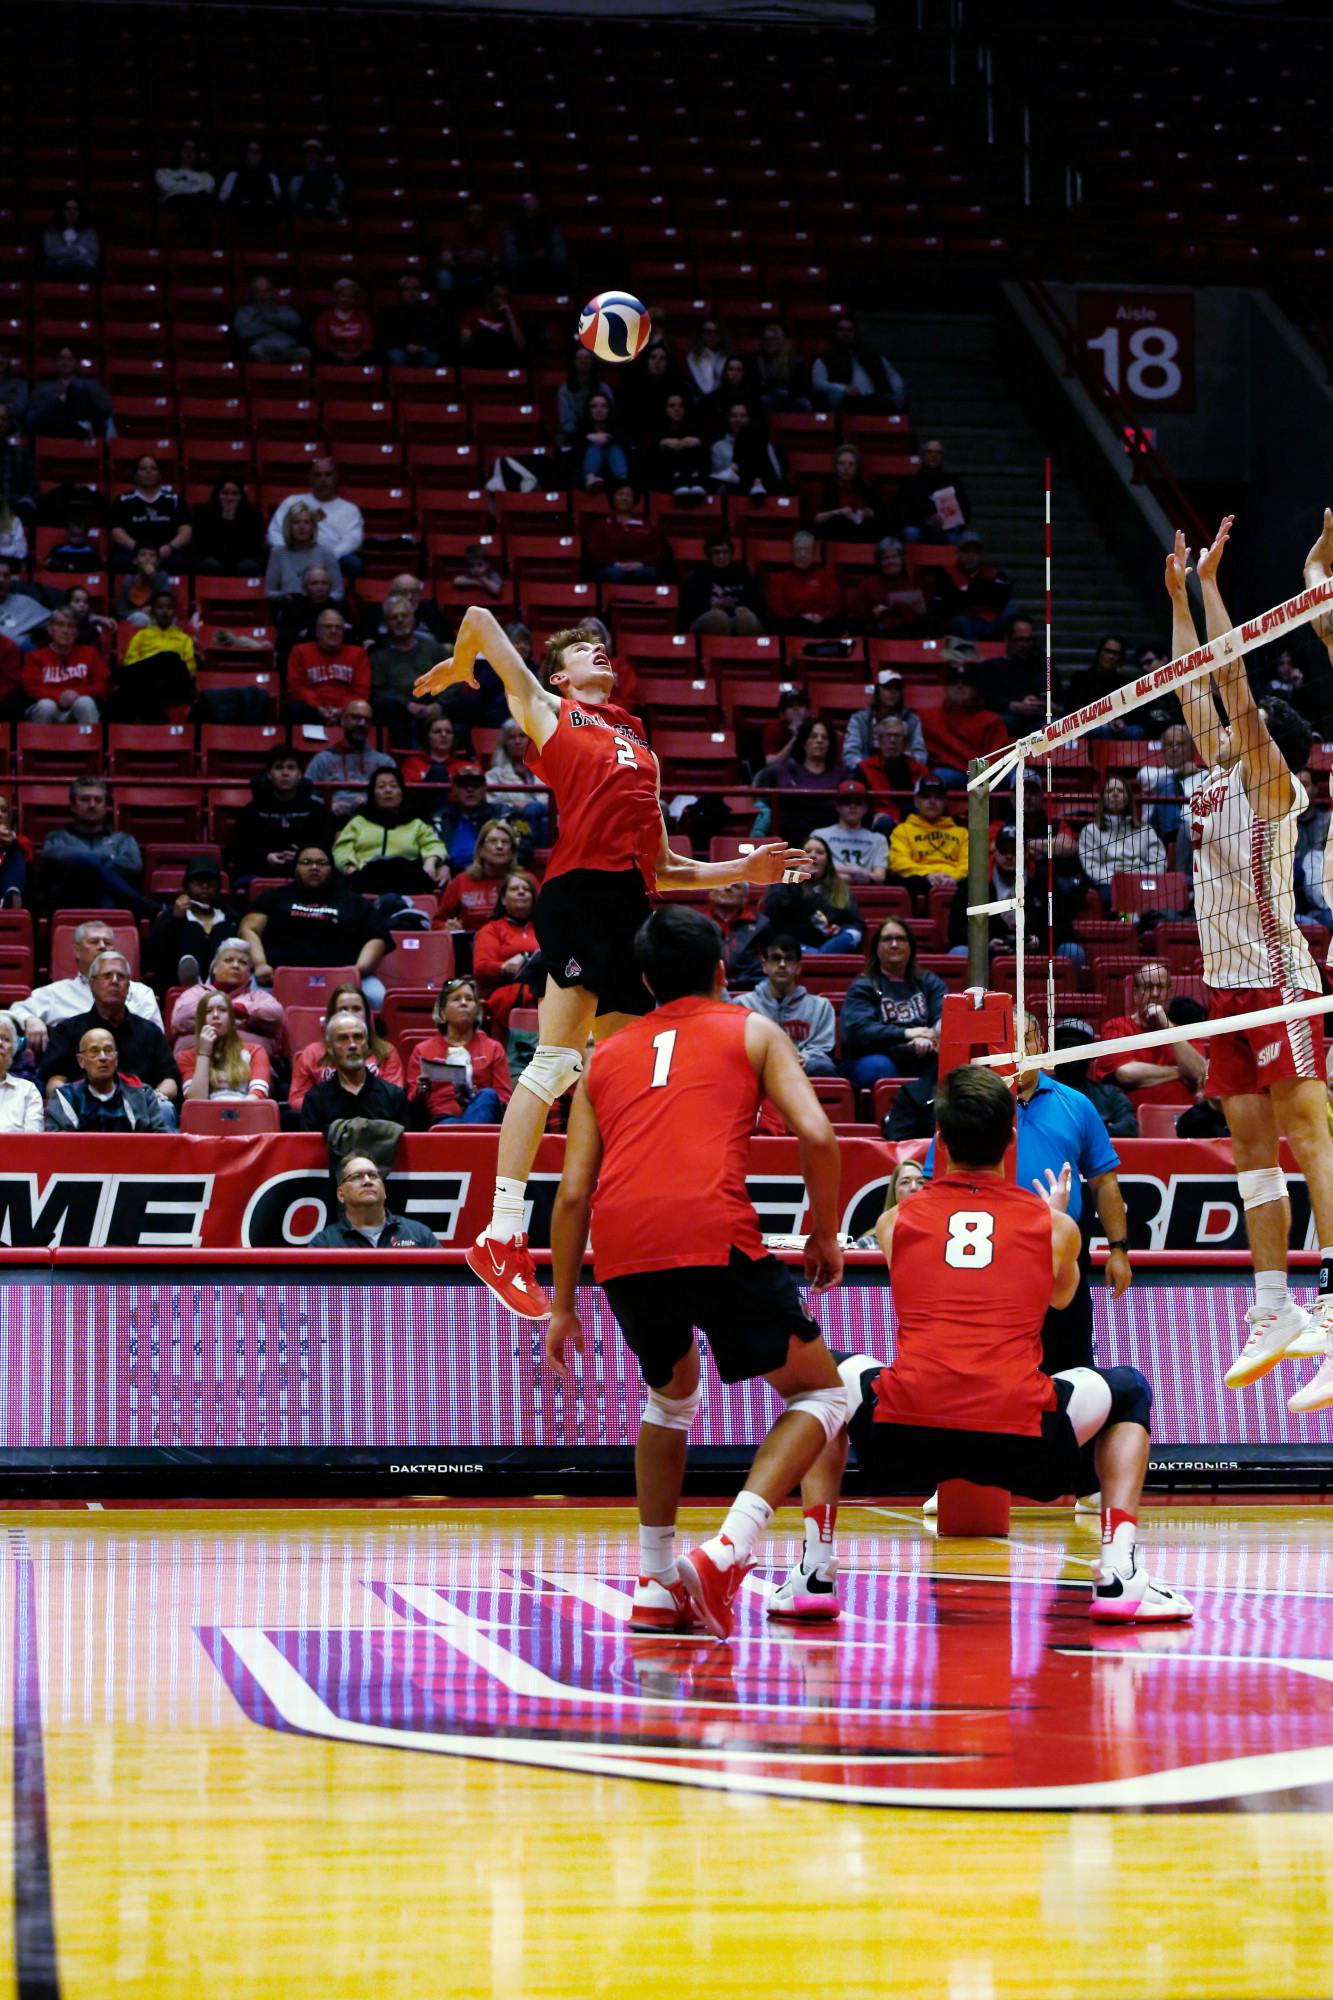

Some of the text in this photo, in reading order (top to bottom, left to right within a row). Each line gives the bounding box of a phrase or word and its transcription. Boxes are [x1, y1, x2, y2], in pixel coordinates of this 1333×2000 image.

[1116, 305, 1157, 320] Aisle
[1087, 326, 1182, 400] 18
[1153, 666, 1173, 688] STATE
[613, 736, 639, 771] 2
[650, 1028, 678, 1088] 1
[1257, 1041, 1282, 1067] SHU
[944, 1209, 996, 1269] 8
[389, 1464, 484, 1473] DAKTRONICS
[1148, 1461, 1239, 1471] DAKTRONICS
